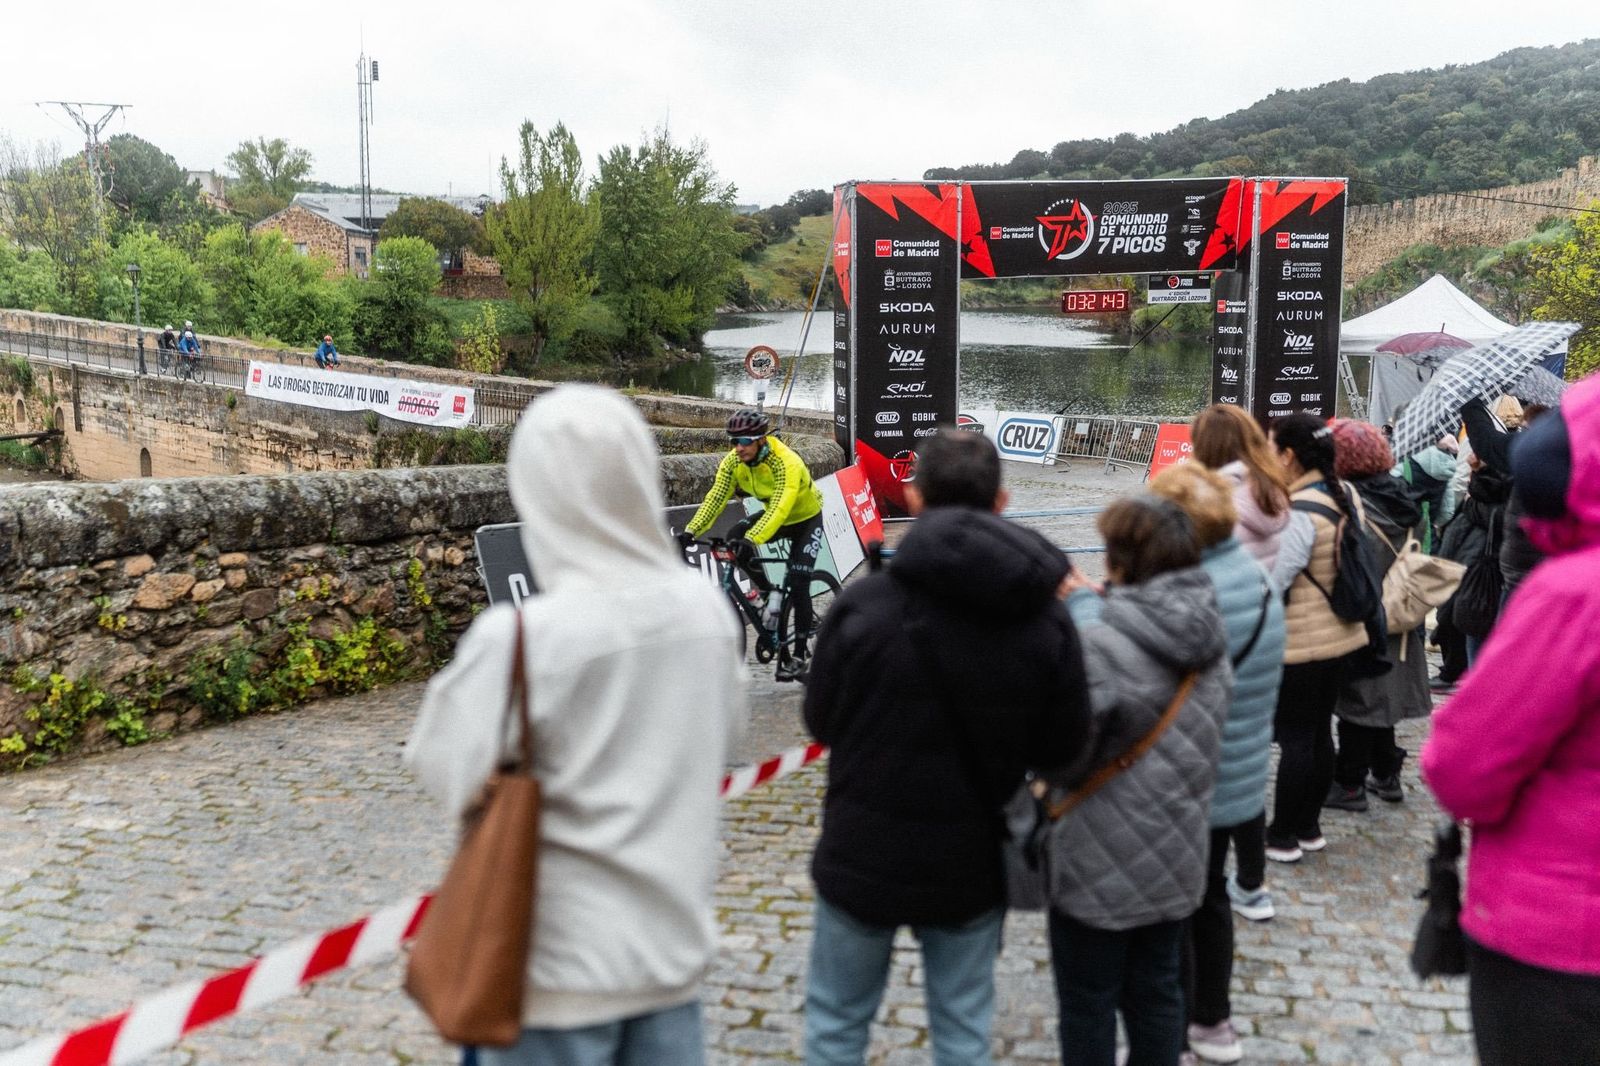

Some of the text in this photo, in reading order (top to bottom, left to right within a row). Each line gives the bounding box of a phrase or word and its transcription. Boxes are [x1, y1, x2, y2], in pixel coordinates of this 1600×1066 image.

[1103, 201, 1138, 215] 2025
[1100, 213, 1169, 226] COMUNIDAD
[1099, 224, 1167, 237] DE MADRID
[1290, 232, 1330, 241] Comunidad
[893, 239, 940, 248] Comunidad
[1097, 235, 1167, 255] 7 PICOS
[1302, 241, 1329, 249] Madrid
[893, 249, 940, 257] de Madrid
[1277, 291, 1324, 301] SKODA
[879, 302, 935, 313] SKODA
[1276, 310, 1324, 321] AURUM
[879, 323, 936, 335] AURUM
[1218, 326, 1244, 335] SKODA
[1283, 334, 1315, 348] NDL
[888, 349, 926, 363] NDL
[1221, 369, 1239, 380] NDL
[268, 374, 283, 390] LAS
[283, 376, 312, 394] DROGAS
[312, 380, 356, 401] DESTROZAN
[356, 386, 368, 402] TU
[369, 388, 390, 406] VIDA
[1300, 393, 1321, 402] GOBIK
[398, 395, 439, 417] DROGAS
[912, 412, 938, 422] GOBIK
[1003, 425, 1048, 450] CRUZ
